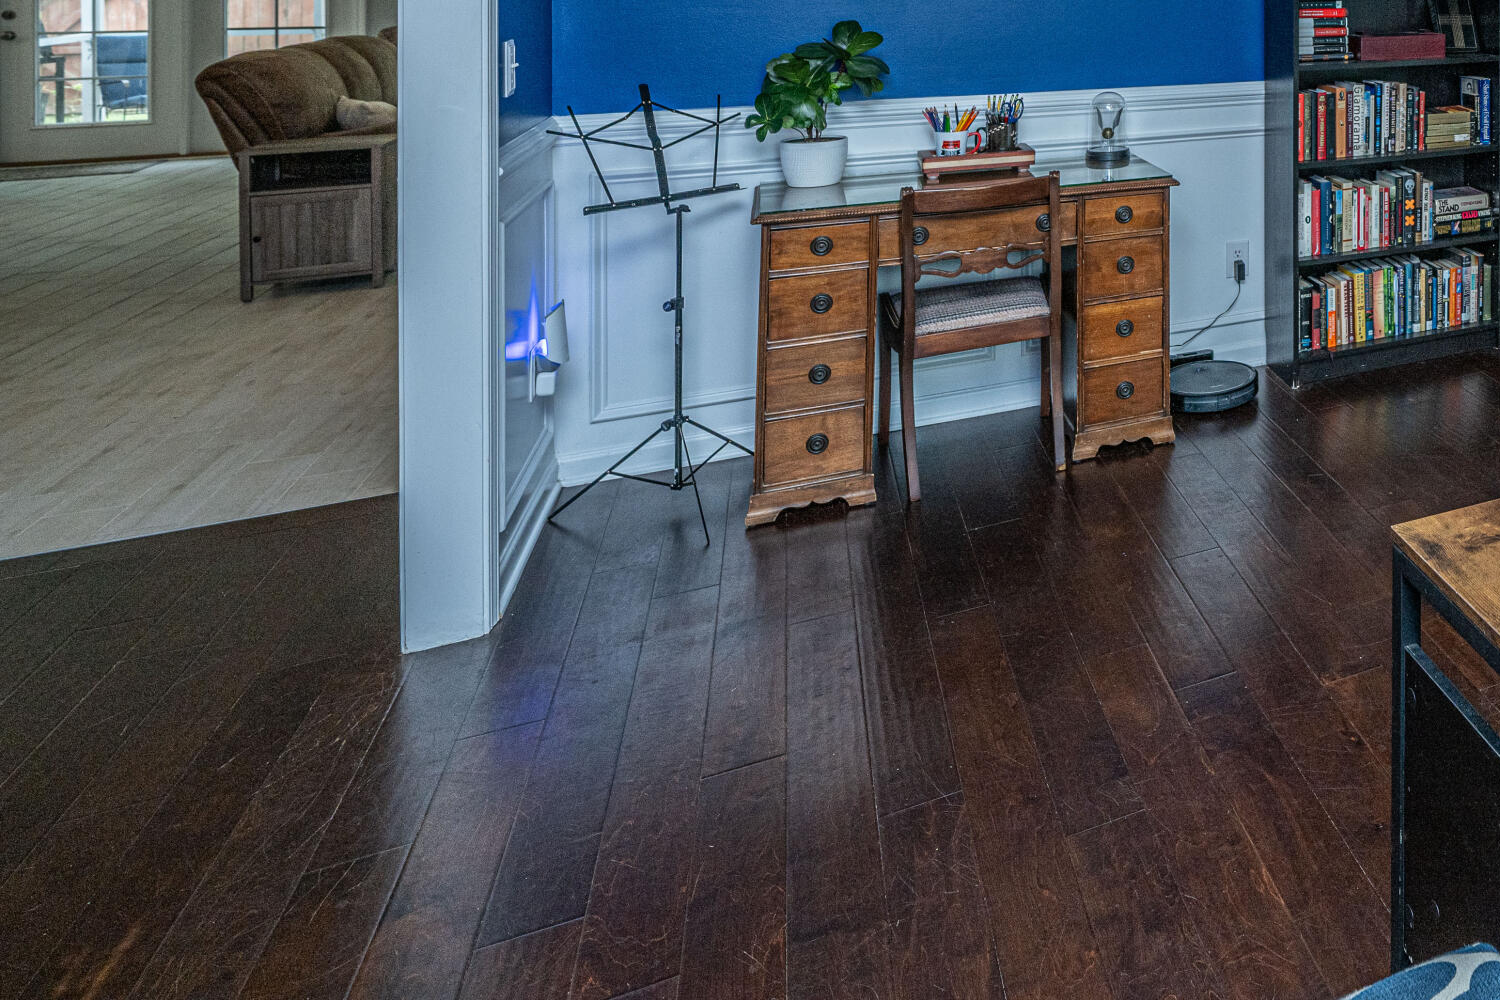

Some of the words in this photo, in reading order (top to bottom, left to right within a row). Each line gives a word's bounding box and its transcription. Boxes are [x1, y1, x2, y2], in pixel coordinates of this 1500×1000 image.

[1353, 87, 1363, 151] Glamorama
[1439, 199, 1449, 207] THE
[1438, 204, 1460, 213] STAND
